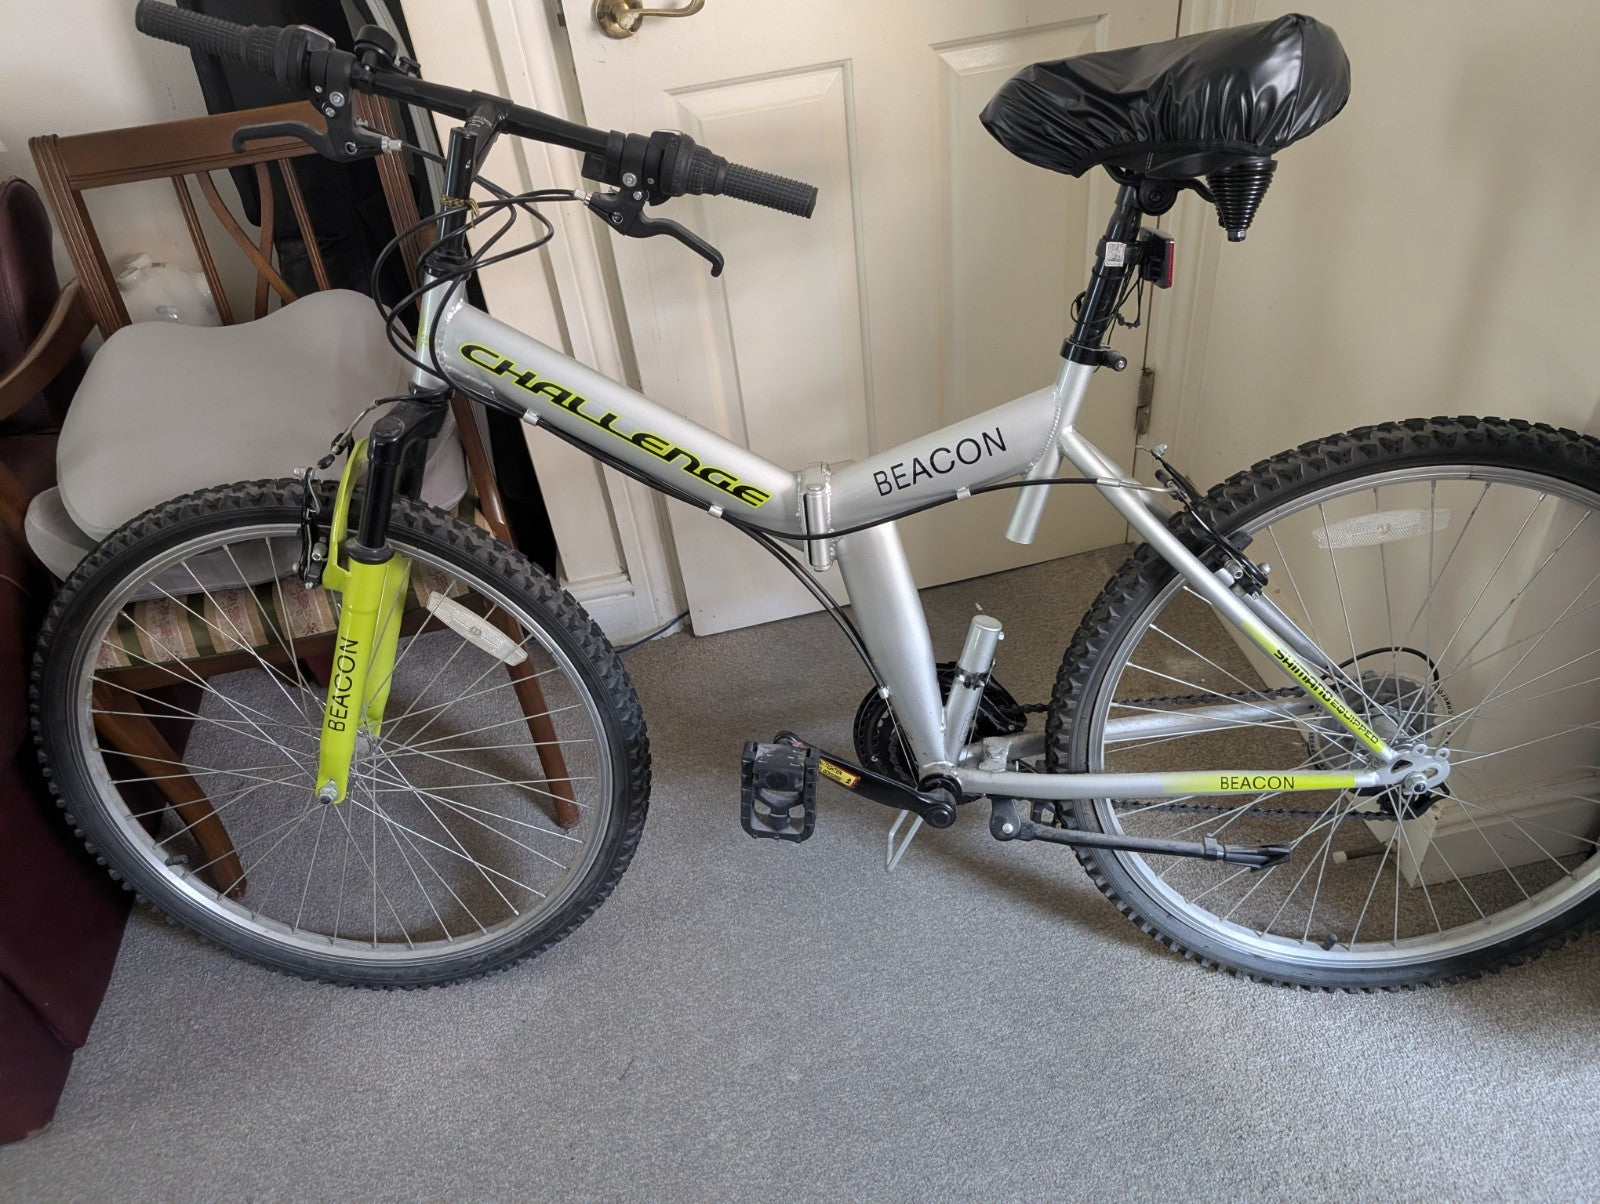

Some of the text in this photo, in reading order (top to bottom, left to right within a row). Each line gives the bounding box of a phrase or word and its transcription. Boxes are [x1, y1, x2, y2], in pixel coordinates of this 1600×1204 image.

[460, 344, 770, 508] CHALLENGE
[873, 427, 1006, 496] BEACON
[327, 636, 358, 732] BEACON
[1274, 649, 1333, 702] SHIMANO
[1330, 699, 1379, 744] EQUIPPED
[1220, 776, 1294, 790] BEACON
